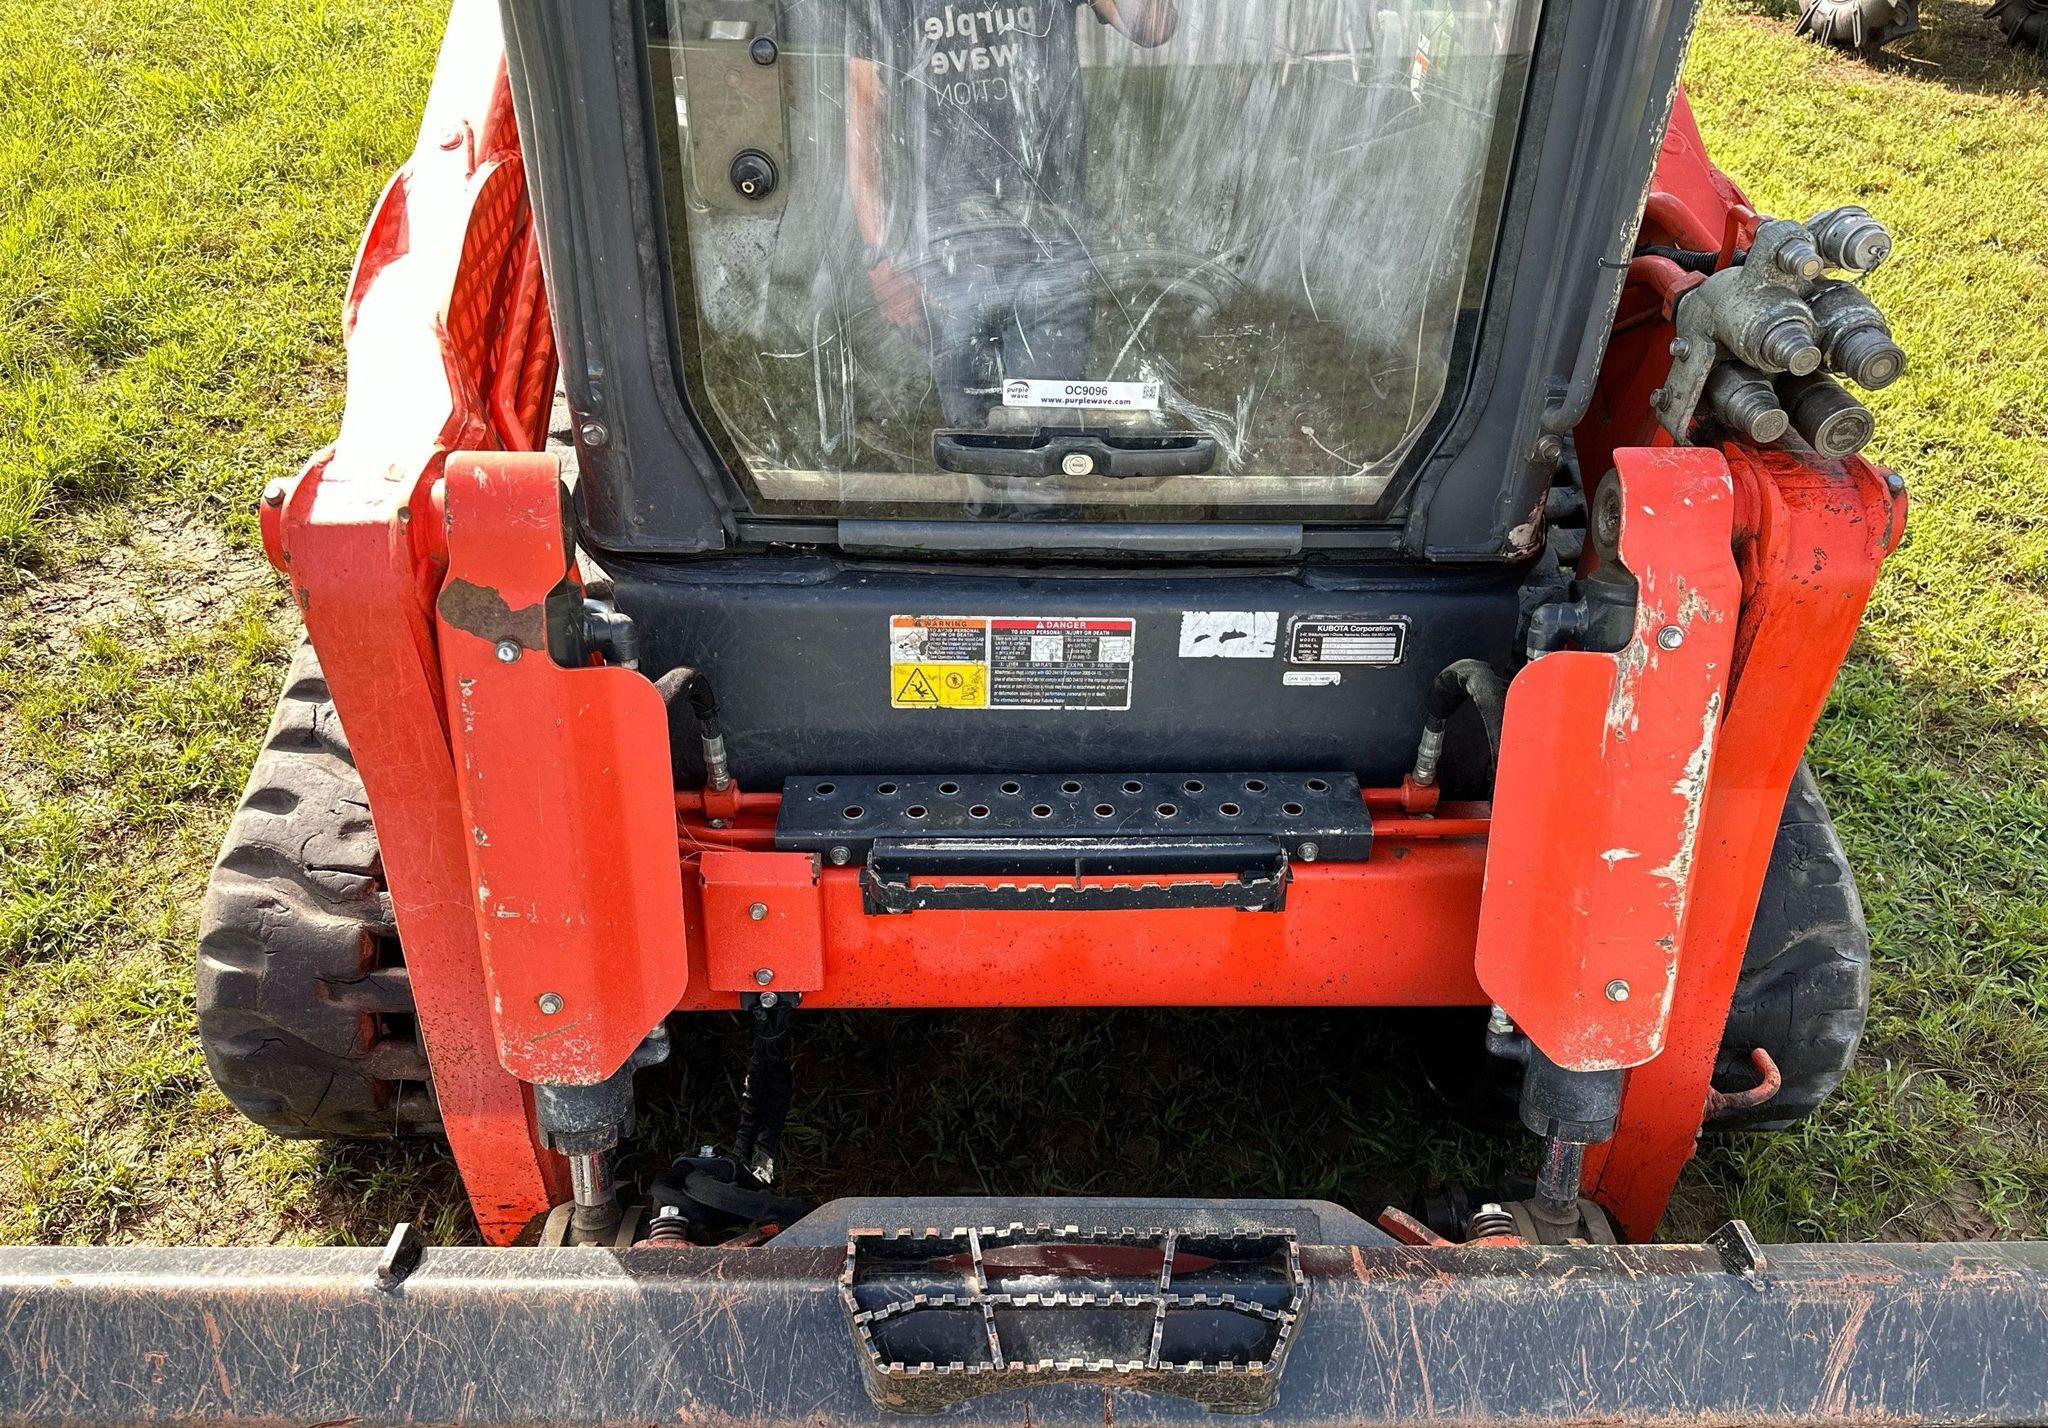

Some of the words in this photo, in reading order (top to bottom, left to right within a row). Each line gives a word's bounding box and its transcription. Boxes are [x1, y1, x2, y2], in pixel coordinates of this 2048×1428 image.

[1006, 386, 1028, 394] purple
[1065, 385, 1108, 396] OC9096
[1040, 396, 1131, 406] www.purplewave.com
